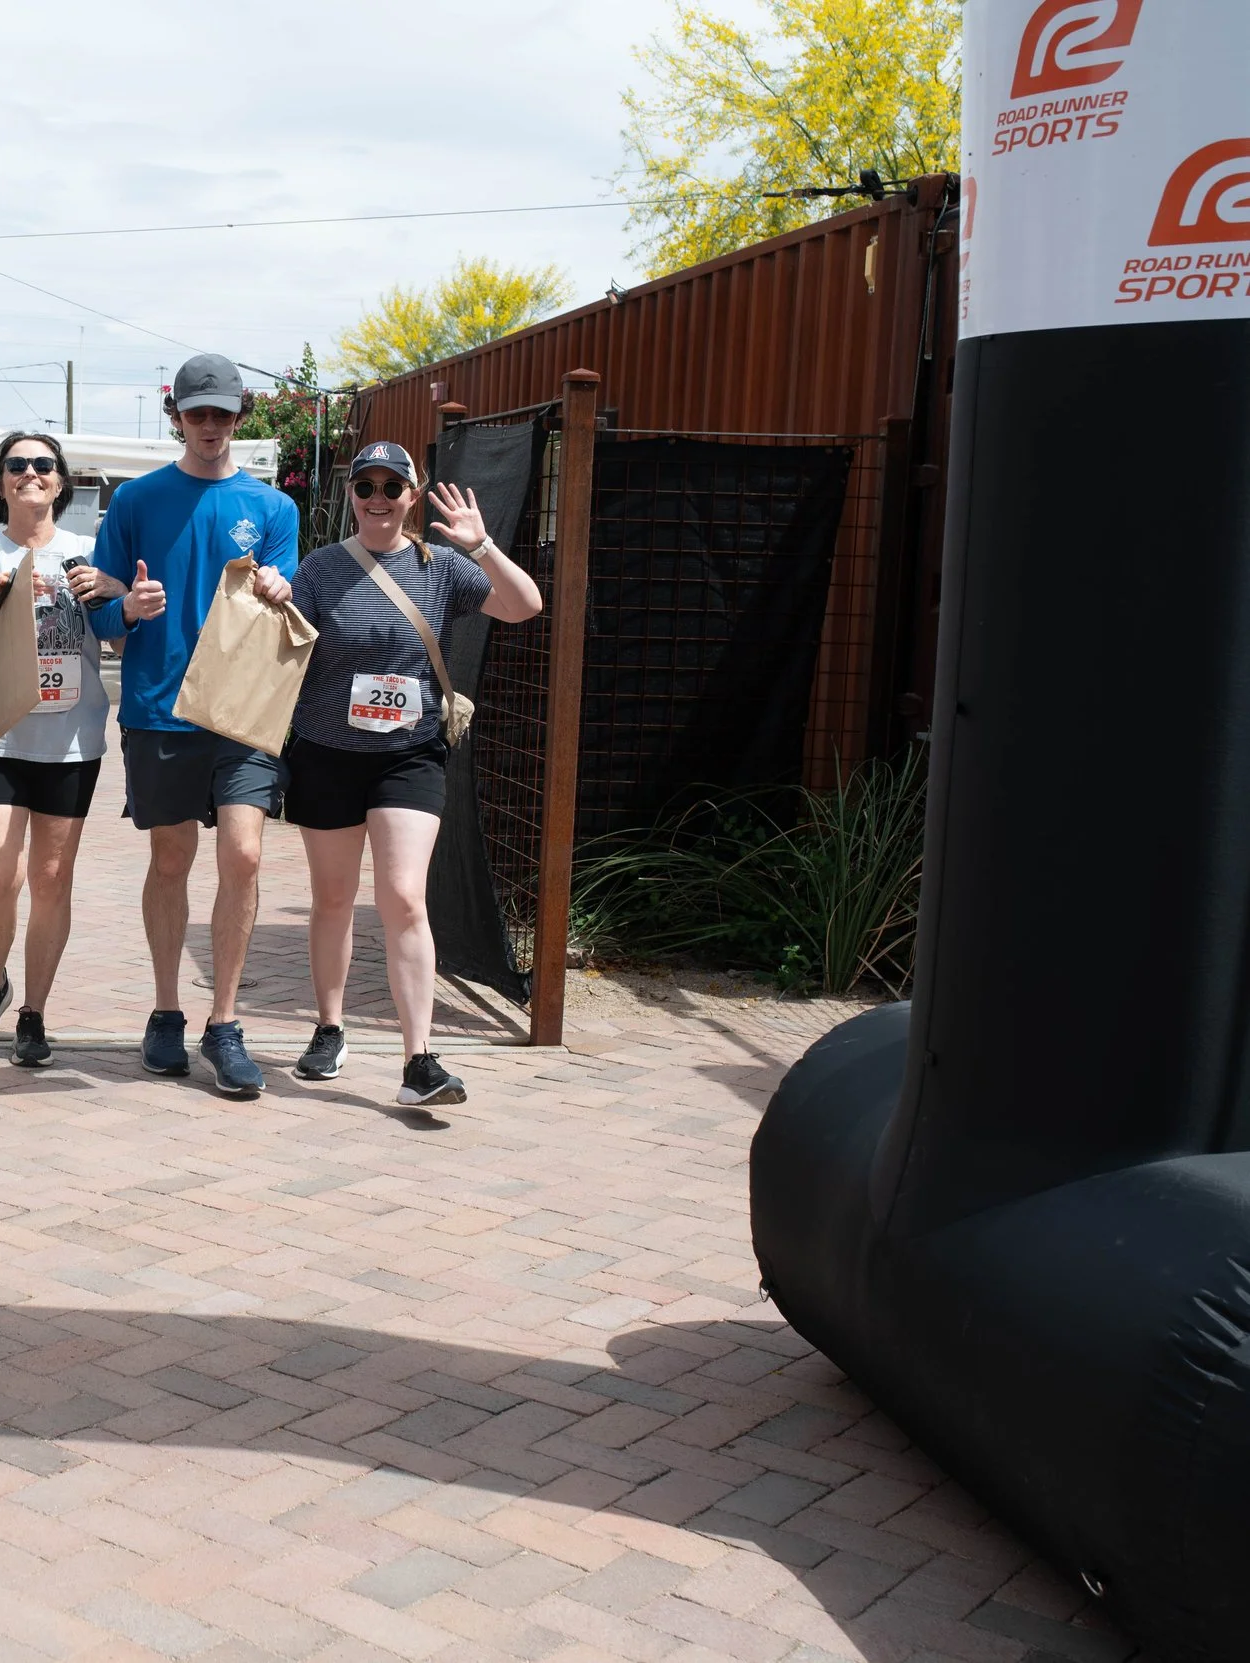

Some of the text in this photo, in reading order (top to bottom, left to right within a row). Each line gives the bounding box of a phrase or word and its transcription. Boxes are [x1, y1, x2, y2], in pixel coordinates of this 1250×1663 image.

[997, 90, 1129, 127] ROAD RUNNER
[991, 110, 1123, 156] SPORTS
[1123, 252, 1250, 274] ROAD RUN
[367, 445, 390, 460] A
[40, 672, 63, 688] 29
[369, 689, 407, 708] 230
